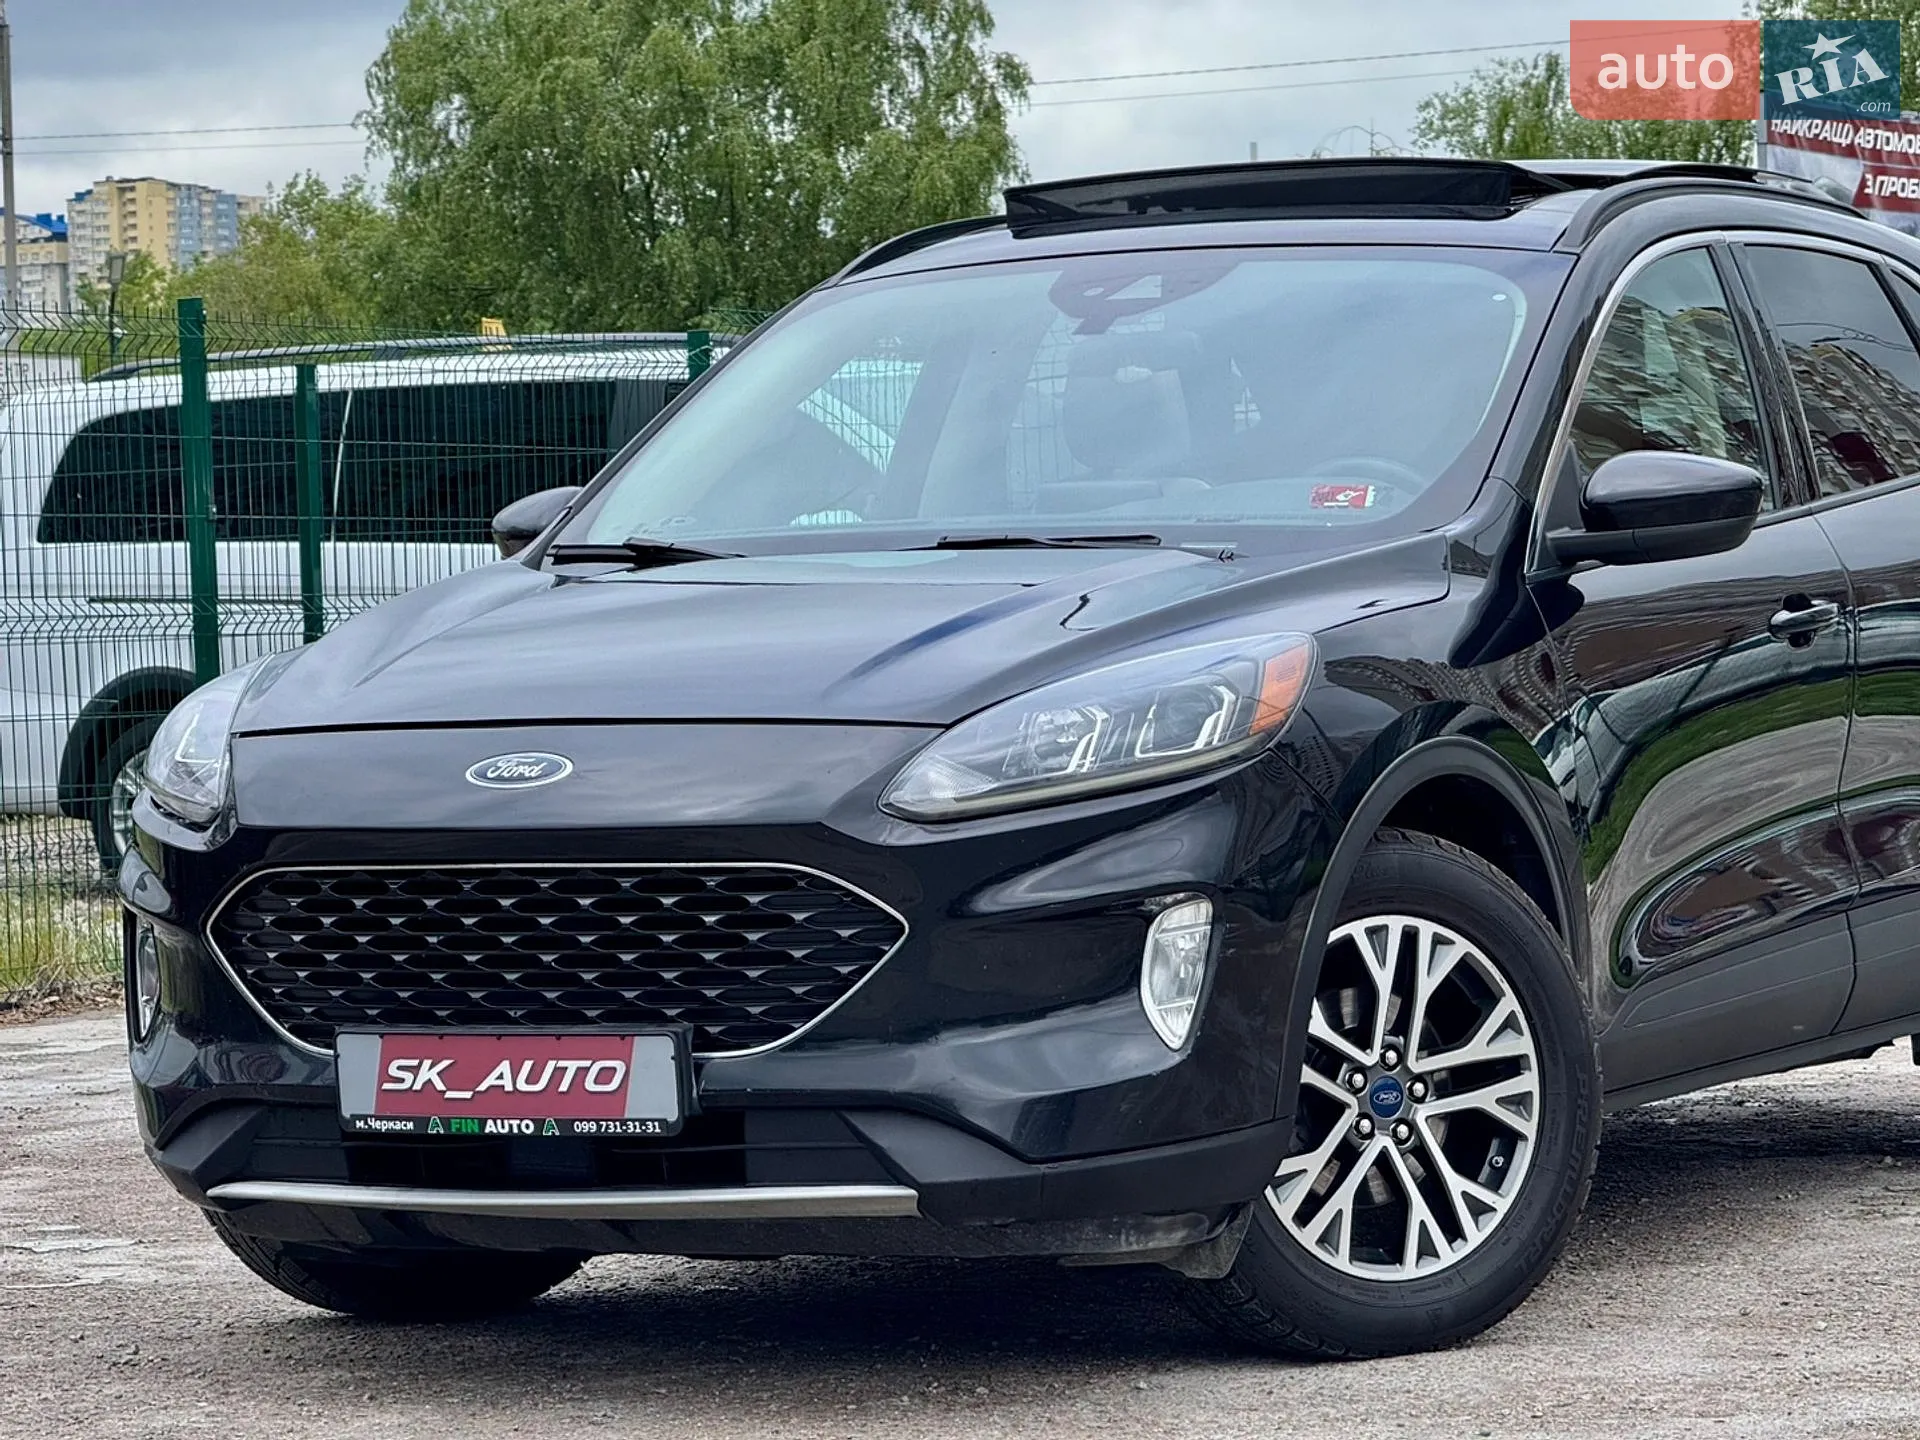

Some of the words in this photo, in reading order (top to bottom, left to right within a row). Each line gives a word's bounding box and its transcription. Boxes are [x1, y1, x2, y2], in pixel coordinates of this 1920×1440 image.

[486, 757, 548, 779] Ford
[381, 1058, 627, 1099] SK_AUTO
[355, 1117, 415, 1132] м.Черкаси
[450, 1118, 480, 1133] FIN
[484, 1118, 535, 1134] AUTO
[573, 1121, 597, 1132] 099
[600, 1121, 661, 1133] 731-31-31
